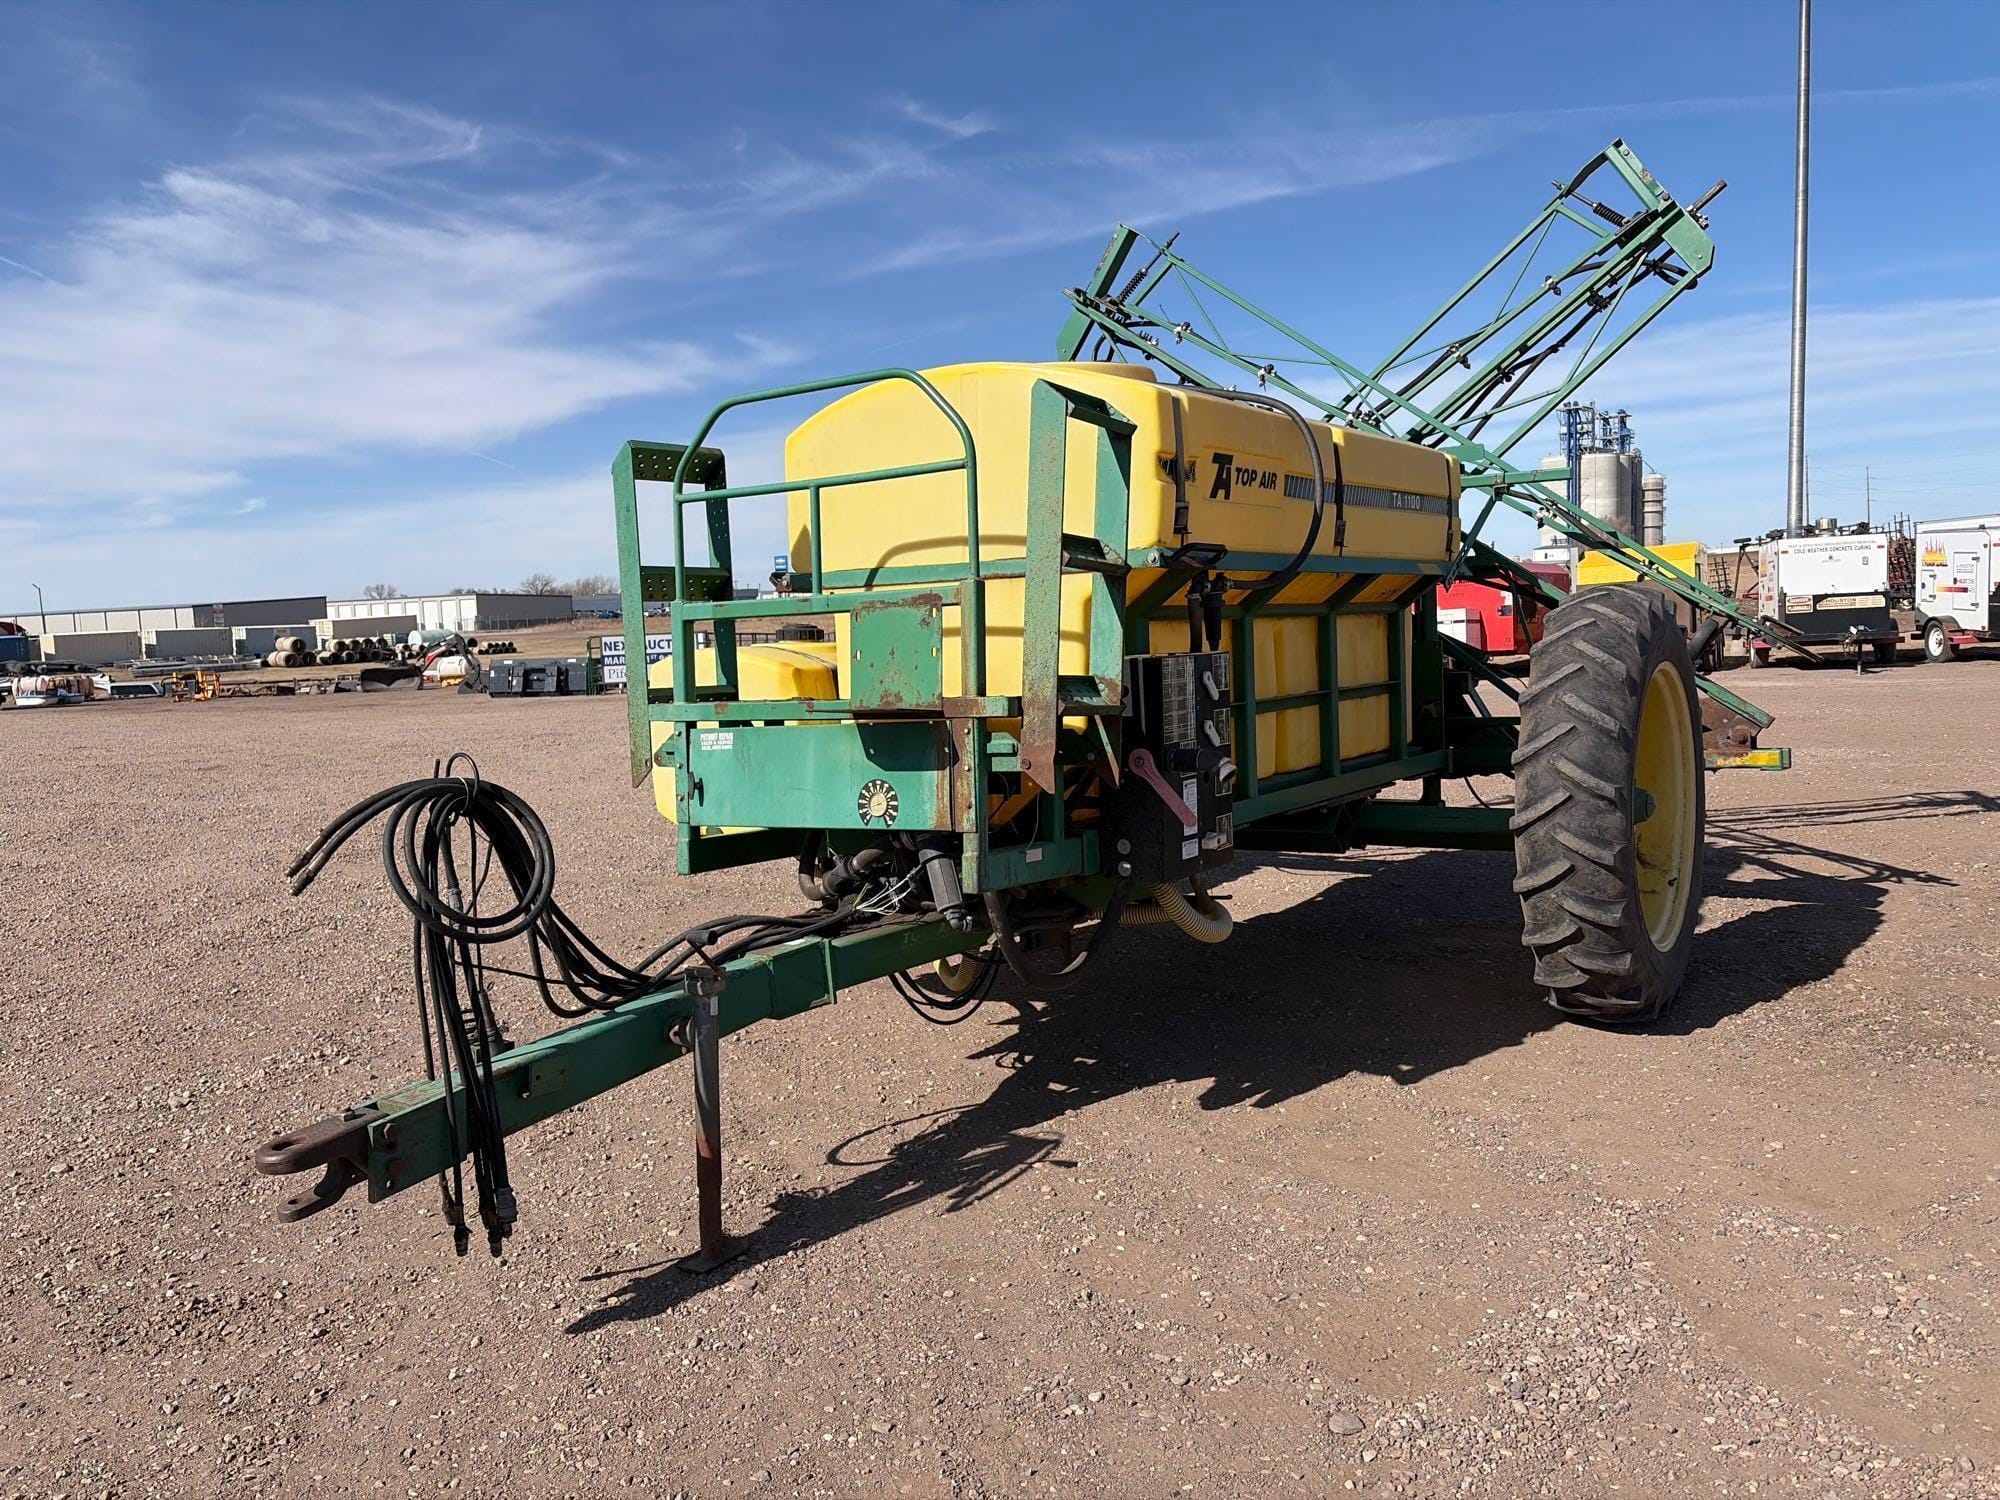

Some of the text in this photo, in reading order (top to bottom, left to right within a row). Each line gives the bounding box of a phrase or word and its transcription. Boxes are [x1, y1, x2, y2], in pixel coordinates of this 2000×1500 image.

[1235, 467, 1278, 490] TOP AIR
[1392, 492, 1421, 510] TA 1100
